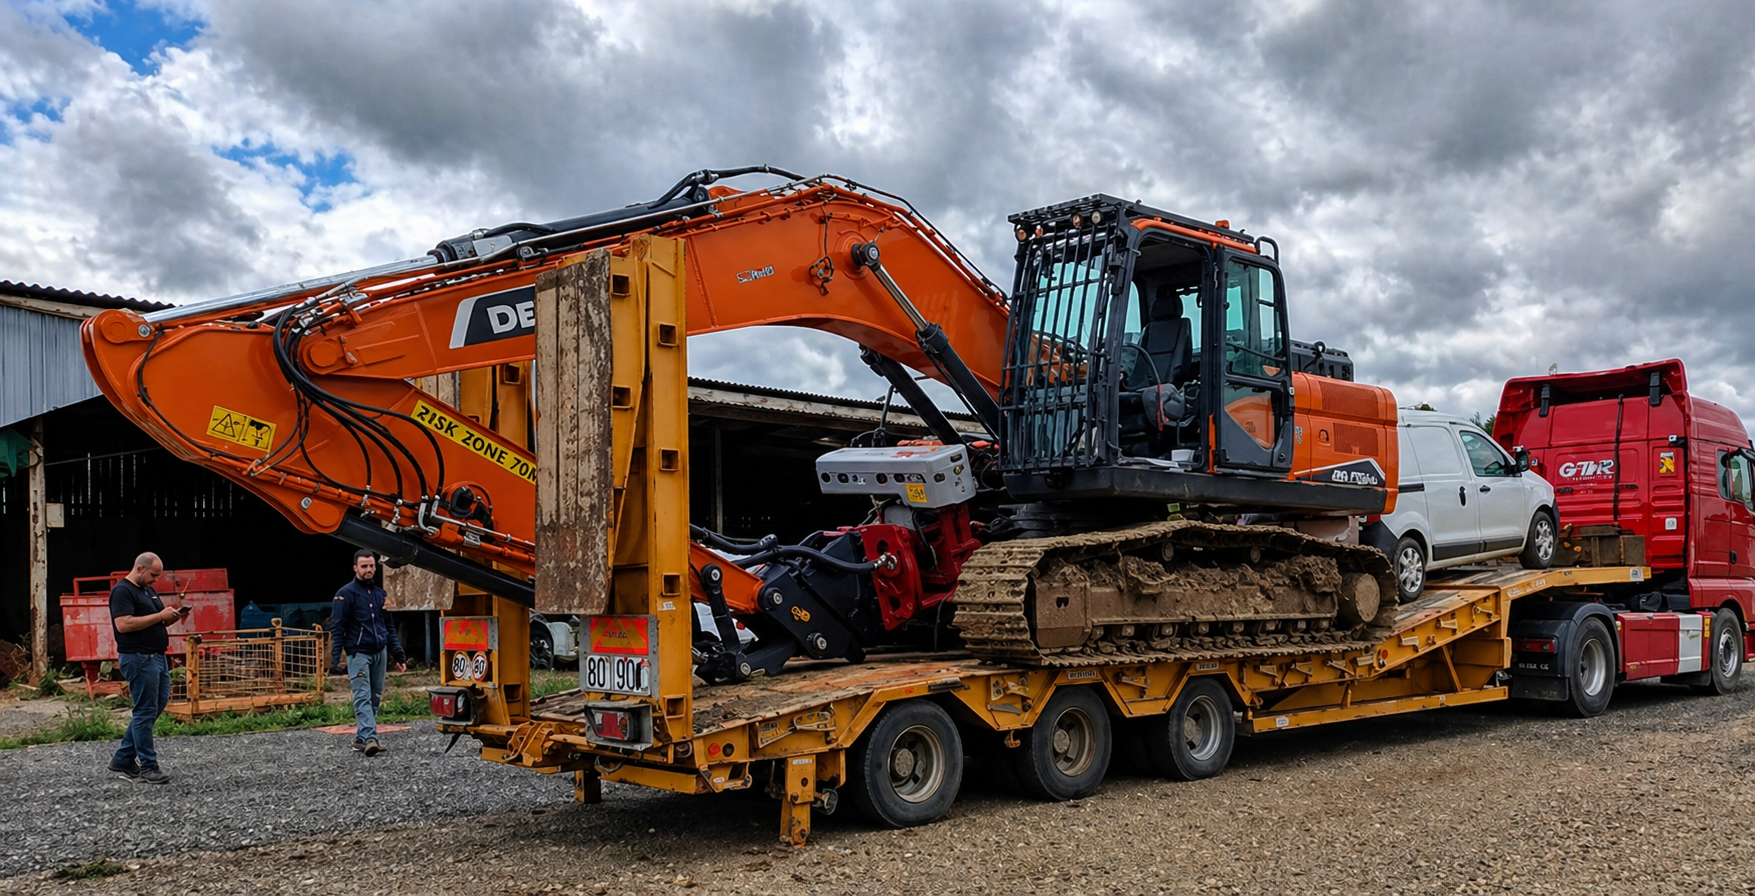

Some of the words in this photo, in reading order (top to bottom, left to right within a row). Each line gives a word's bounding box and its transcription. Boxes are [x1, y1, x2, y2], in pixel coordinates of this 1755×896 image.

[487, 301, 535, 334] DE
[461, 430, 508, 465] ZONE
[453, 657, 465, 673] 80
[588, 657, 606, 687] 80
[616, 658, 636, 690] 90
